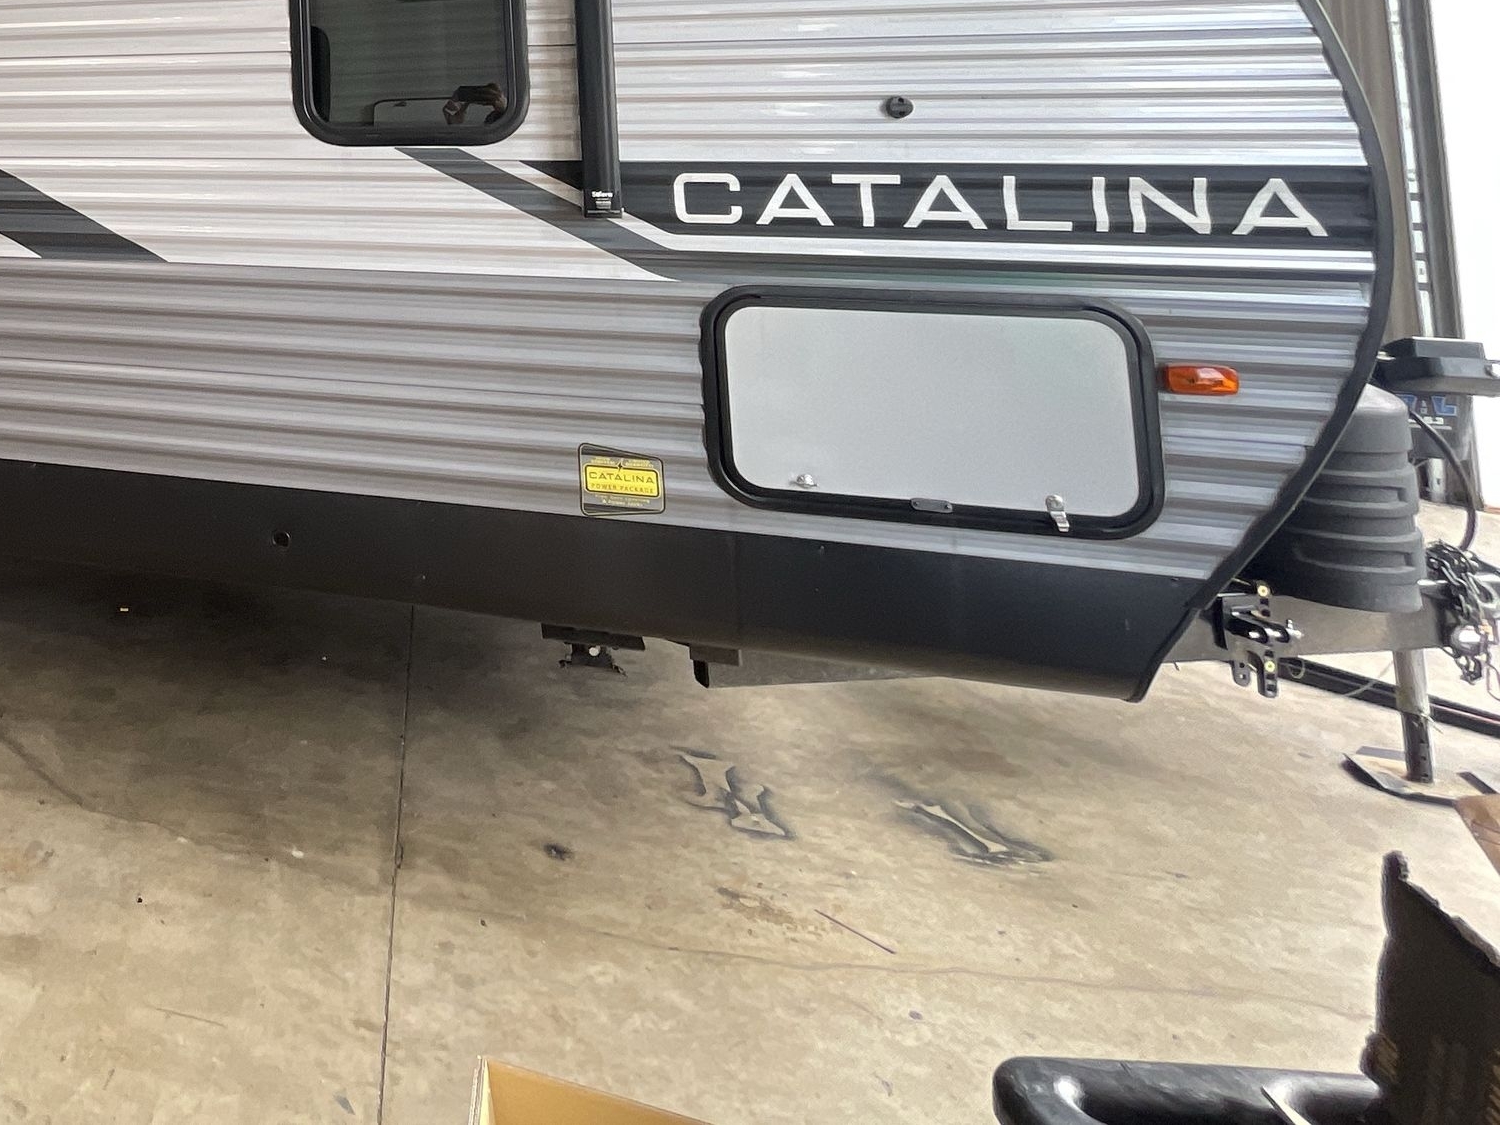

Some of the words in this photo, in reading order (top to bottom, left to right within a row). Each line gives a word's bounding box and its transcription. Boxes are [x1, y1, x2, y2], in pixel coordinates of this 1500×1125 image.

[671, 172, 1329, 237] CATALINA
[588, 471, 655, 484] CATALINA
[590, 482, 617, 491] POWER
[620, 486, 655, 494] PACKAGE
